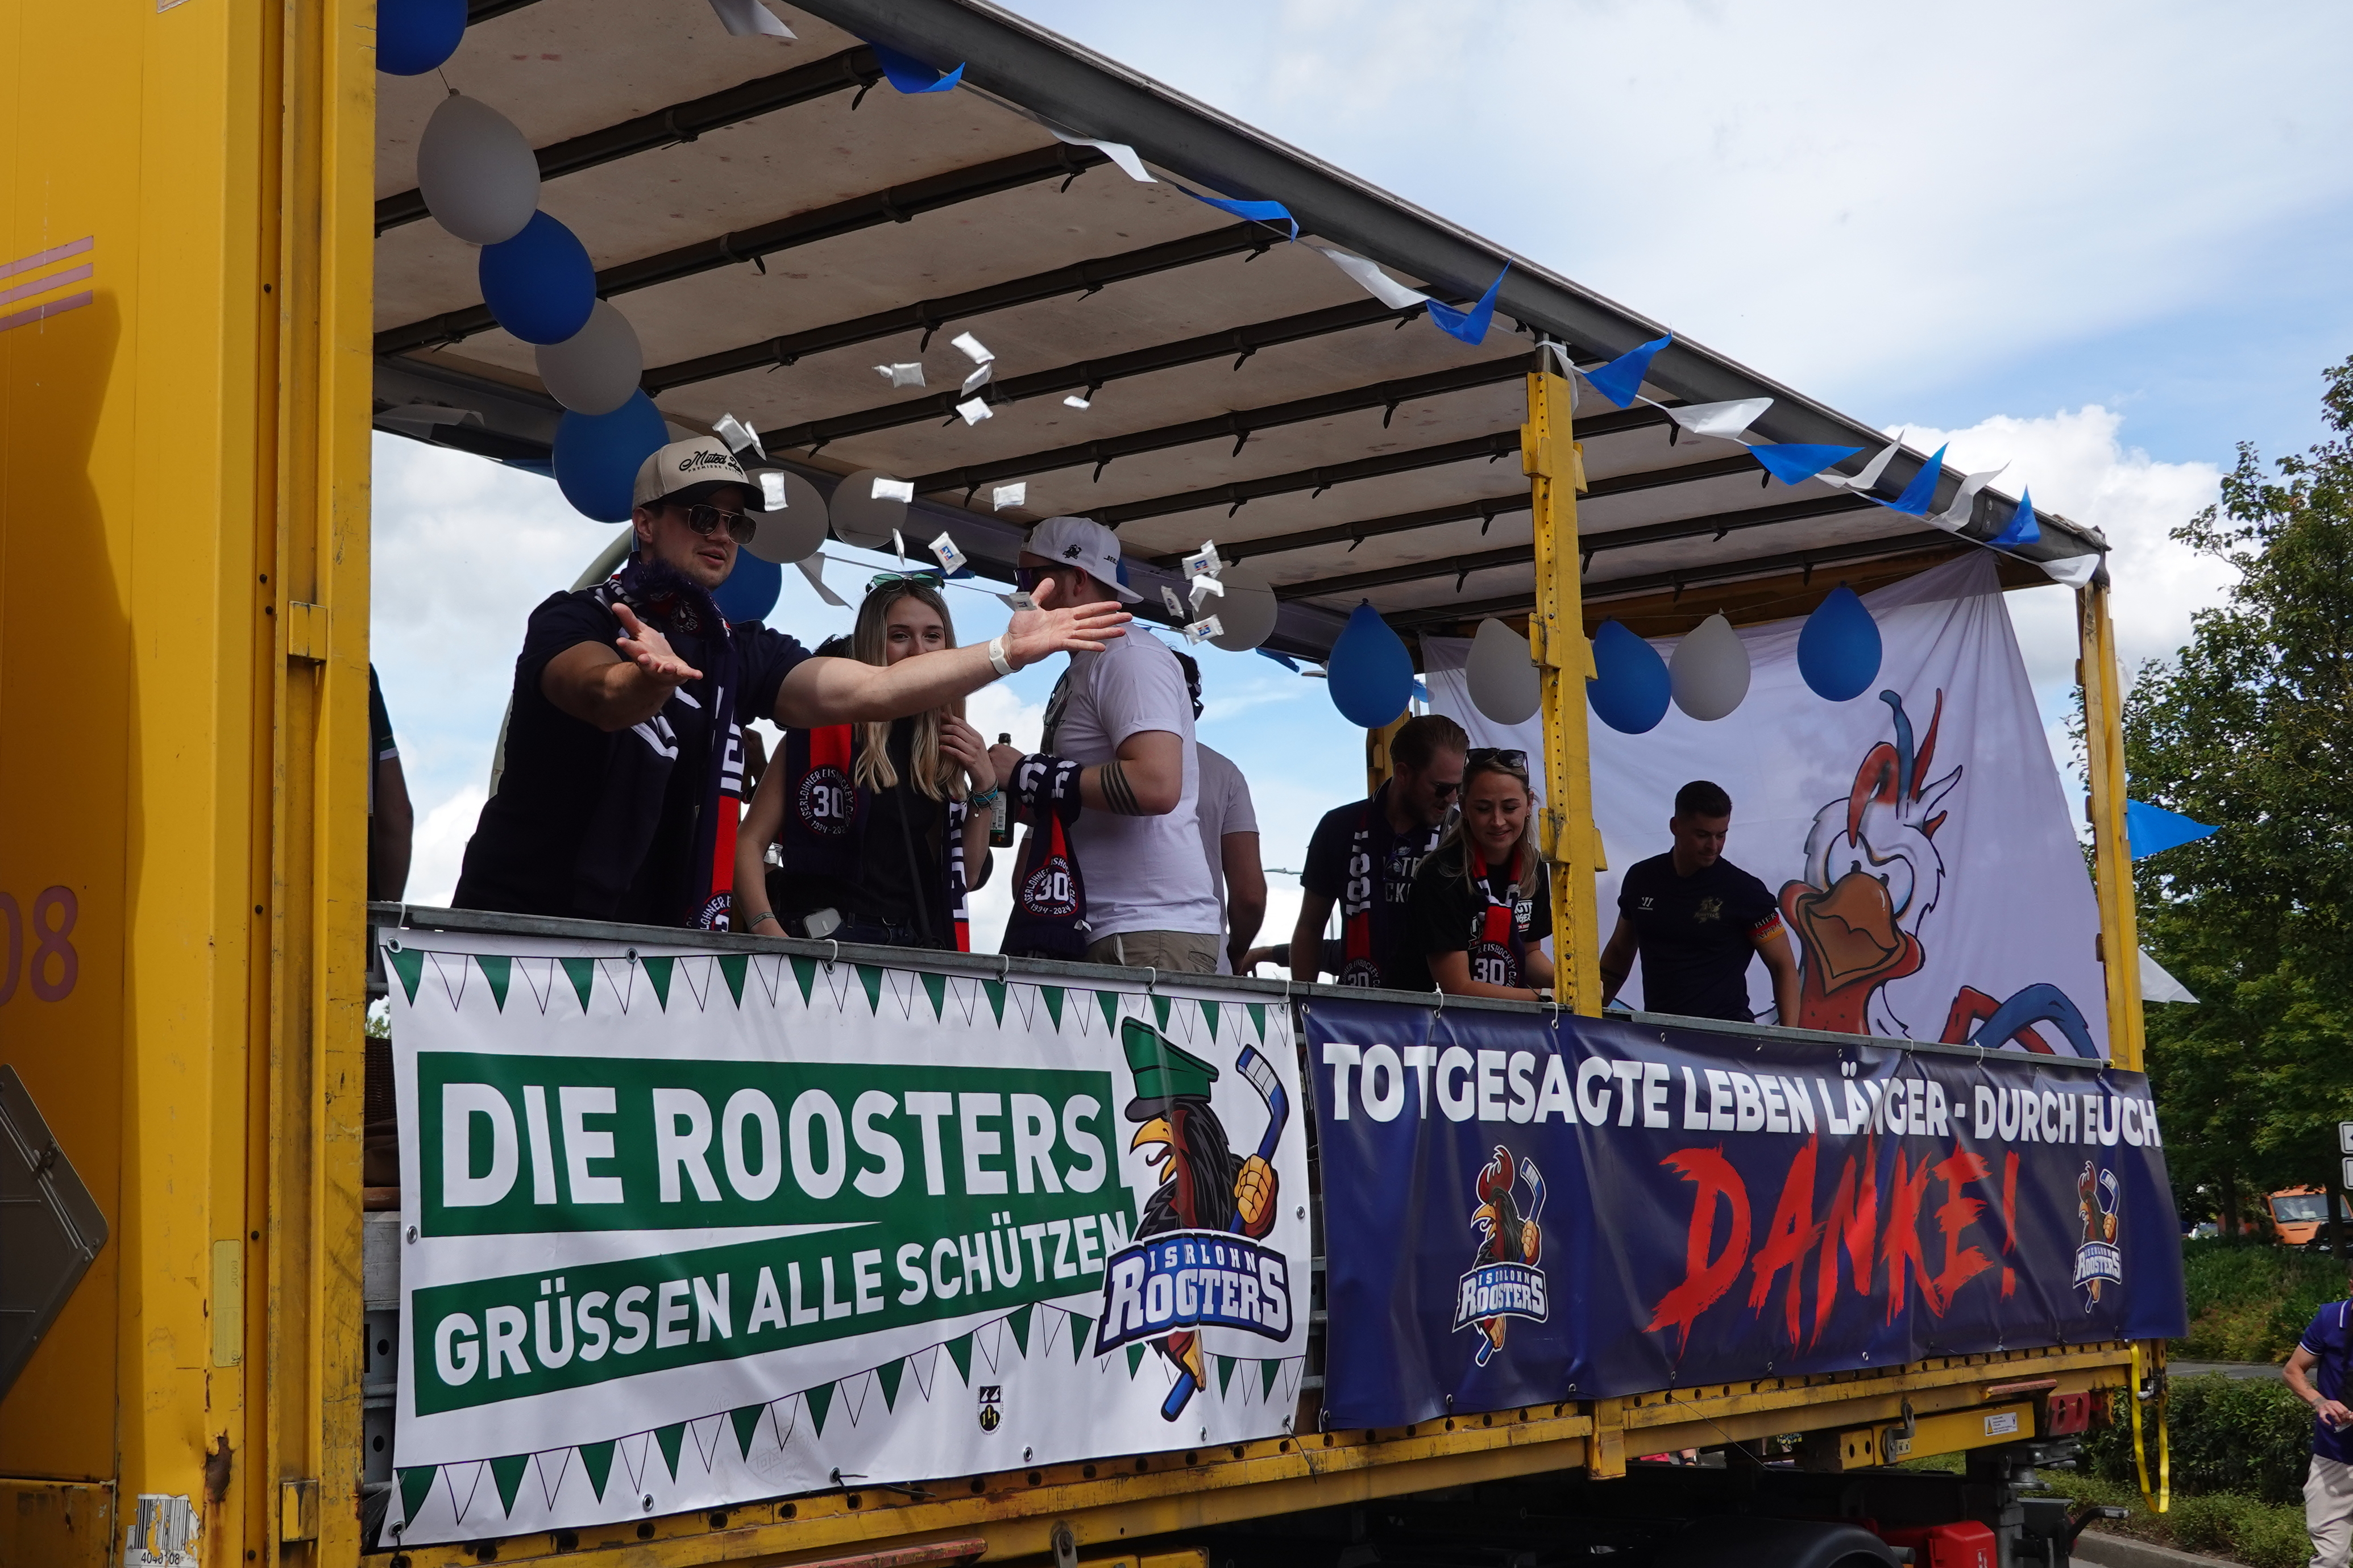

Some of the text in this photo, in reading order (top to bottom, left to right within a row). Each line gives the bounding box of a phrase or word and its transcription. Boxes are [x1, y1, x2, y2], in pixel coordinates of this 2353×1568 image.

[799, 771, 821, 820] ISERLOHNER
[812, 785, 845, 820] 30
[1034, 872, 1069, 901] 30
[1473, 958, 1505, 985] 30
[1483, 943, 1516, 970] EISHOCKEY
[1322, 1042, 1670, 1129] TOTGESAGTE
[1682, 1066, 1816, 1134] LEBEN
[1816, 1060, 1949, 1137] LÄNGER
[1975, 1085, 2077, 1143] DURCH
[2083, 1095, 2161, 1147] EUCH
[442, 1083, 1107, 1208] DIE ROOSTERS
[1642, 1128, 2020, 1364] DANKE!
[2075, 1250, 2120, 1282] ROOSTERS
[435, 1210, 1131, 1386] GRÜSSEN ALLE SCHÜTZEN
[1458, 1275, 1545, 1322] ROOSTERS
[1478, 1270, 1530, 1286] ISERLOHN
